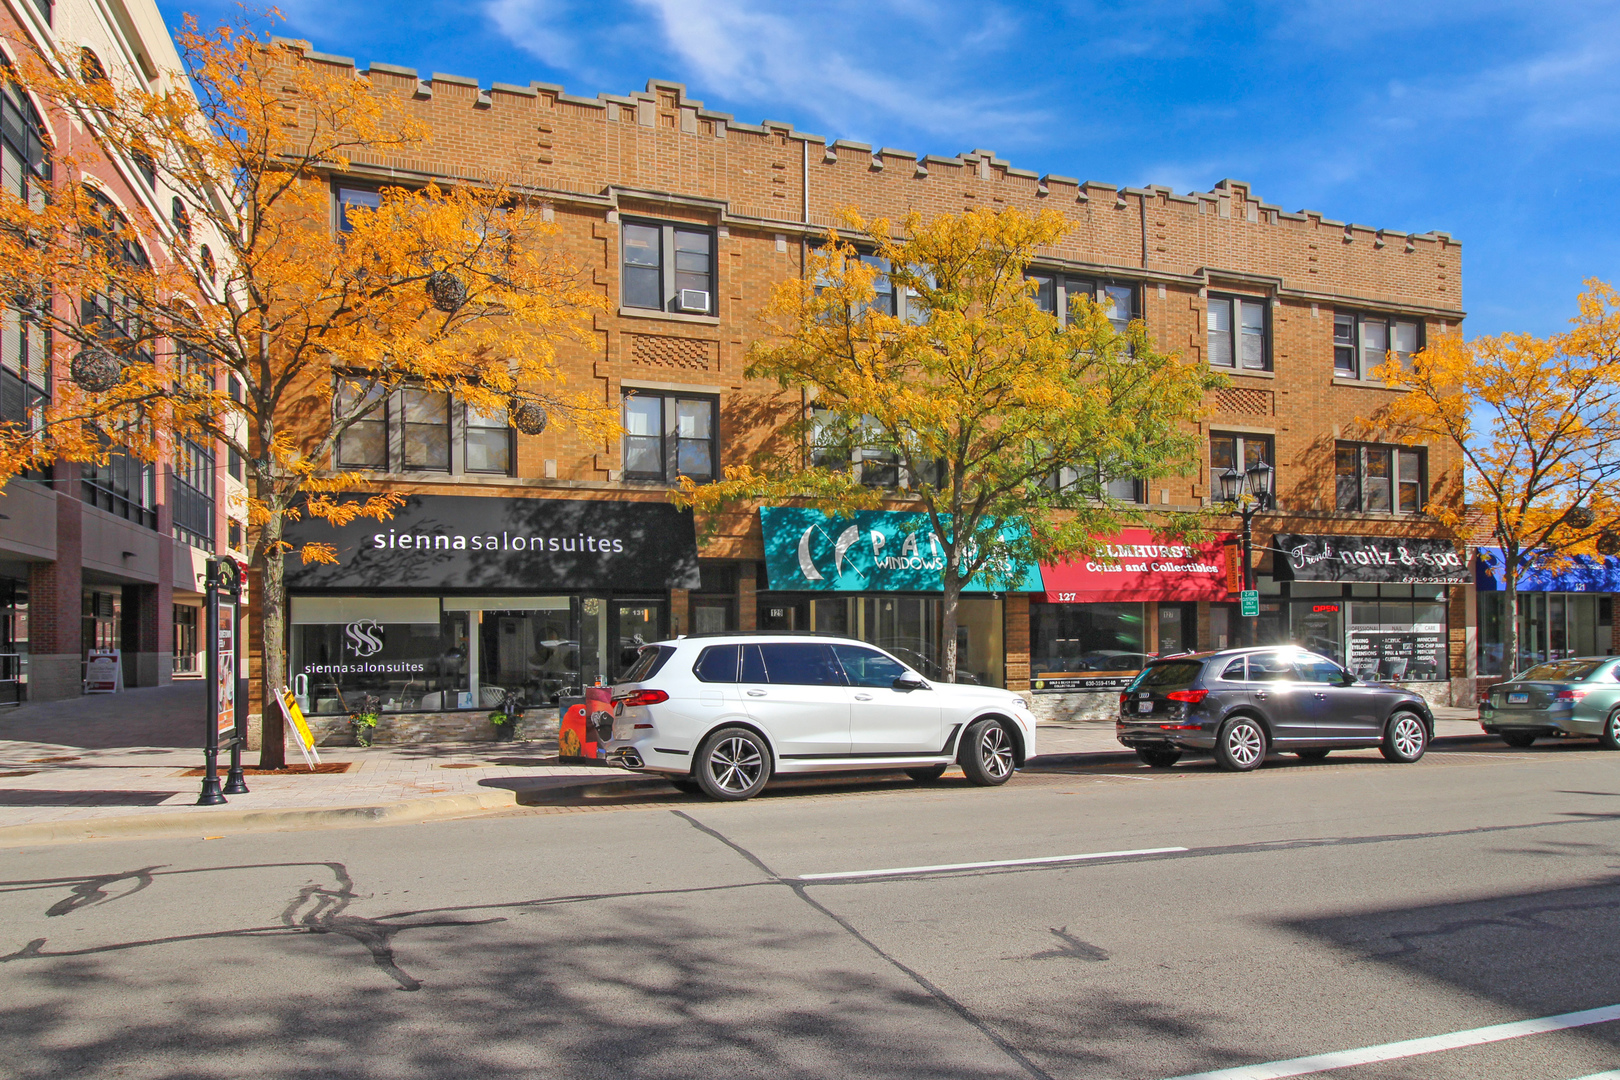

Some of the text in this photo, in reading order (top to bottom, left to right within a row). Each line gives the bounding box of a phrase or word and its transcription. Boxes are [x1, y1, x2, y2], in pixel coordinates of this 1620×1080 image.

[373, 528, 624, 553] siennasalonsuites
[1095, 544, 1192, 558] ELMHURST
[1291, 543, 1464, 571] Trendi nailz & spa
[874, 556, 944, 571] WINDOWS
[1086, 562, 1219, 574] Coins and Collectibles
[1058, 593, 1076, 601] 127
[305, 661, 424, 674] siennasalonsuites
